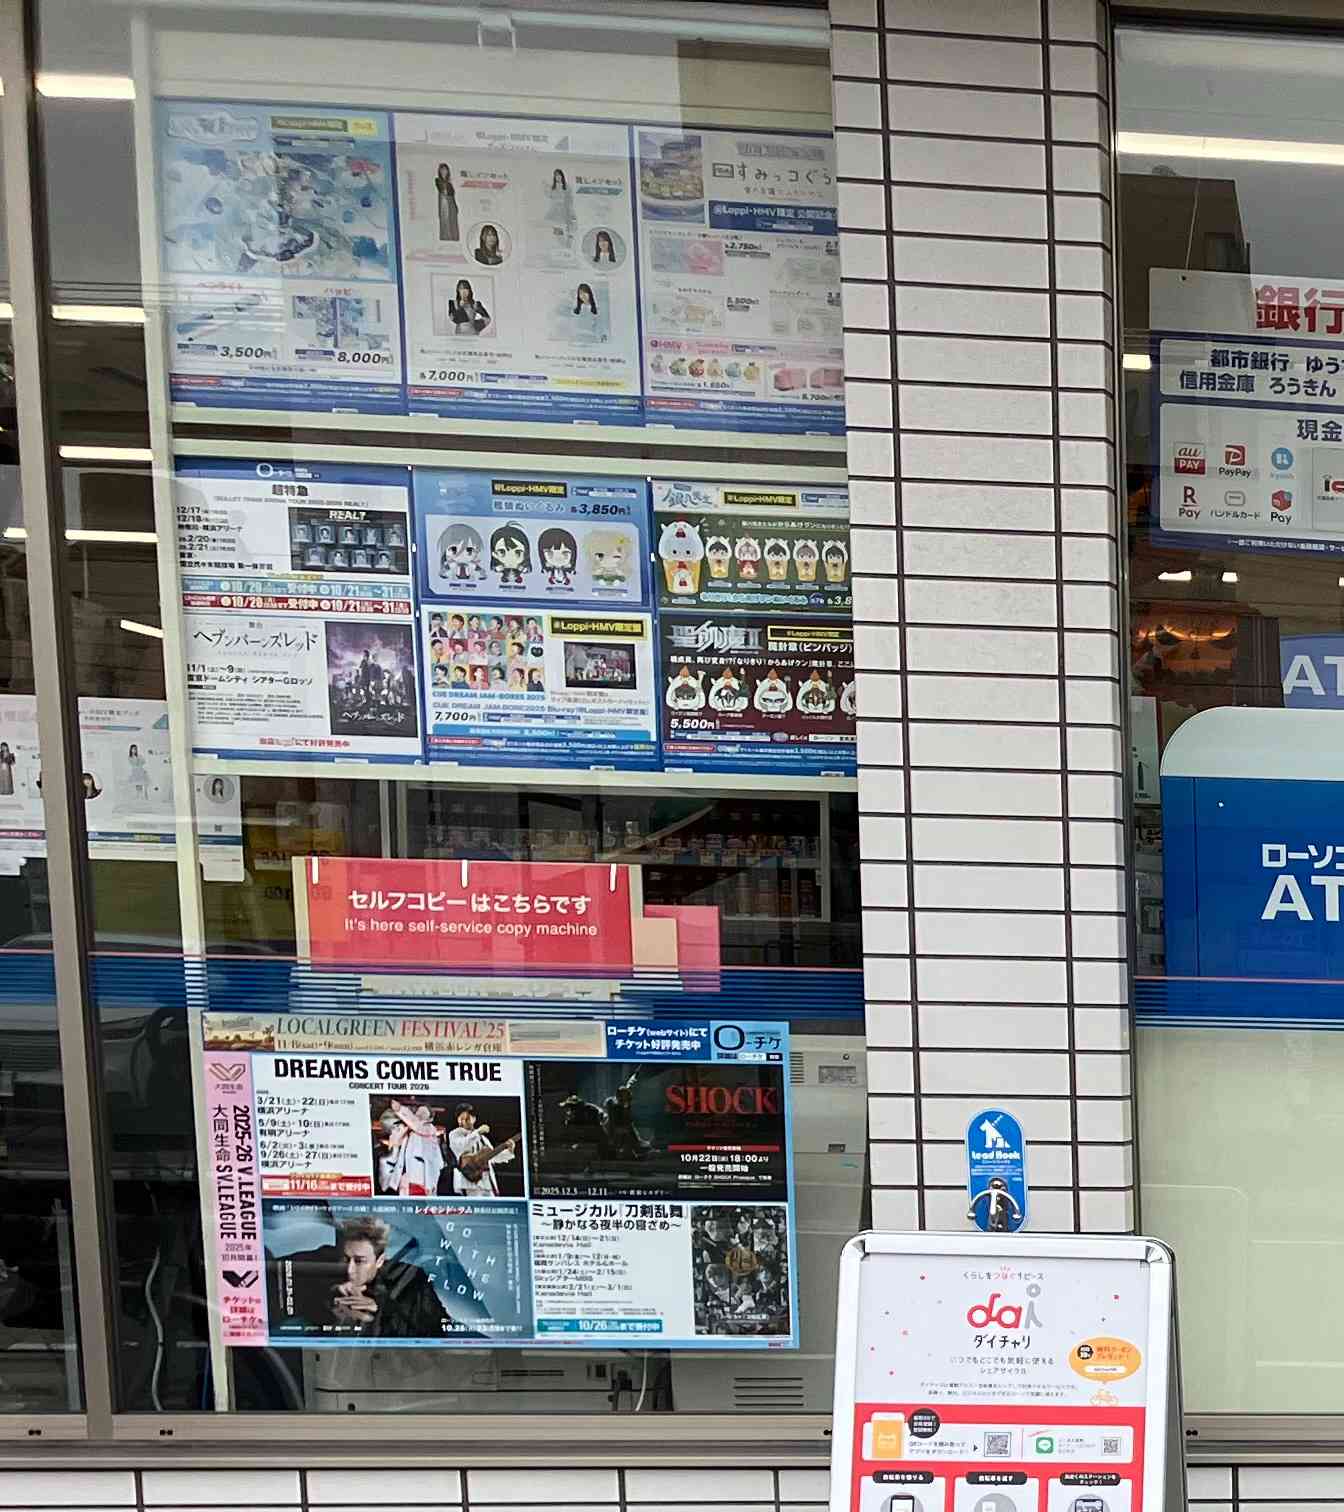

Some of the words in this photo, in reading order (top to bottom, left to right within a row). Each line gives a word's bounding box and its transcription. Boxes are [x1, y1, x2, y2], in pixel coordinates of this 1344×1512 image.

[1209, 347, 1291, 371] 都市銀行
[1179, 370, 1256, 394] 信用金庫
[1268, 376, 1338, 398] ろうきん
[1178, 447, 1202, 457] au
[1178, 459, 1201, 470] PAY
[1219, 467, 1251, 479] PayPay
[1178, 507, 1201, 519] Pay
[1270, 511, 1292, 525] Pay
[348, 889, 592, 916] セルフコピーはこちらです
[370, 918, 404, 933] here
[408, 919, 493, 936] self-service
[496, 921, 532, 938] copy
[536, 921, 598, 936] machine
[277, 1017, 396, 1037] LOCALGREEN
[401, 1018, 481, 1039] FESTIVAL
[274, 1058, 369, 1080] DREAMS
[376, 1060, 439, 1081] COME
[445, 1062, 502, 1082] TRUE
[348, 1082, 385, 1090] CONCERT
[387, 1082, 408, 1090] TOUR
[664, 1085, 780, 1115] SHOCK
[212, 1104, 231, 1161] 大同生命
[232, 1104, 253, 1162] 2025-26
[971, 1150, 995, 1161] Lead
[996, 1150, 1021, 1160] Hook
[215, 1164, 237, 1240] SV.LEAGUE
[236, 1164, 257, 1240] V.LEAGUE
[427, 1273, 486, 1301] FLOW
[973, 1334, 1031, 1349] ダイチャリ
